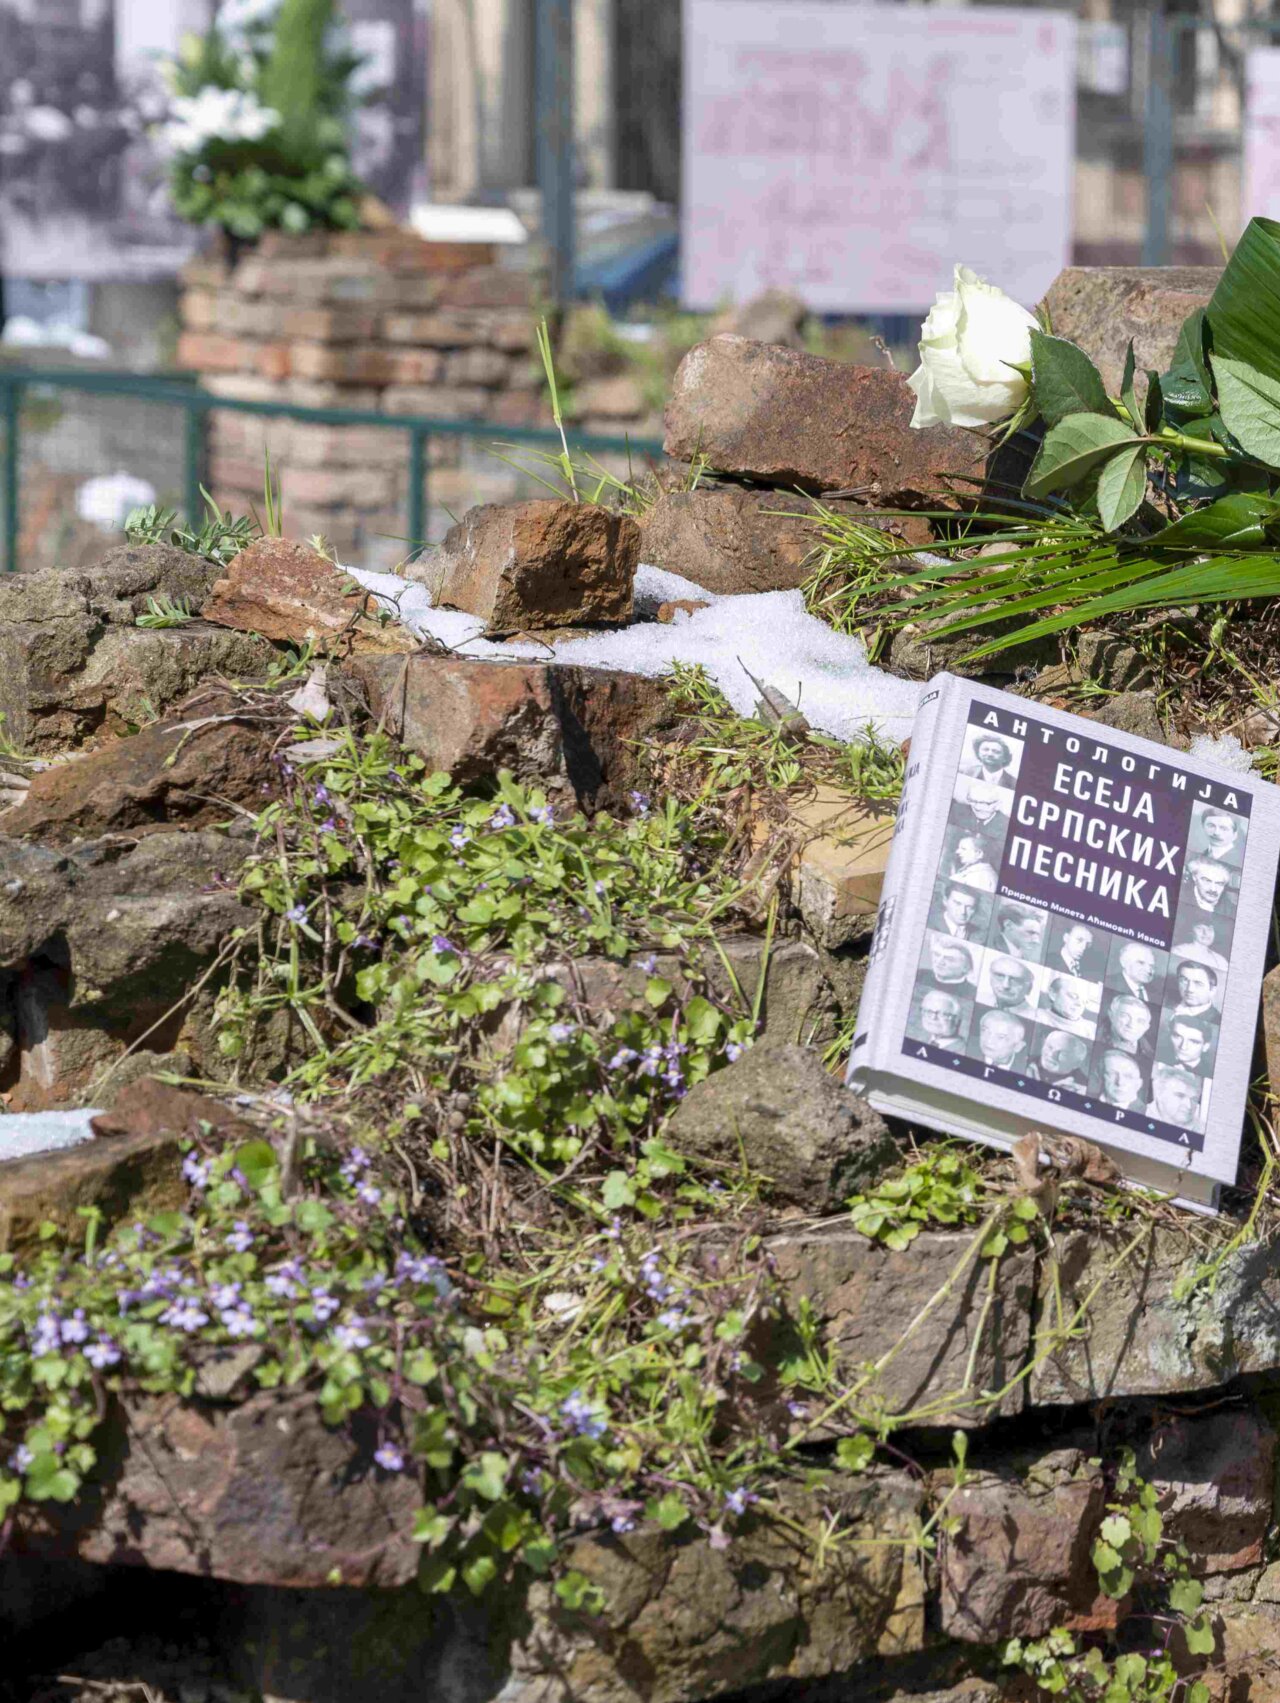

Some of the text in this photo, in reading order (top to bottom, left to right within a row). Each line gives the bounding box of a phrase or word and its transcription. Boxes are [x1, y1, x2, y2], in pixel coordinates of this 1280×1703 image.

[984, 711, 1239, 809] АНТОЛОГИЈА
[1053, 762, 1155, 823] ЕСЕЈА
[1017, 795, 1180, 876] СРПСКИХ
[1001, 885, 1048, 907] Приредио
[1050, 902, 1085, 920] Милета
[1137, 930, 1166, 947] Ивков
[1008, 835, 1170, 918] ПЕСНИКА
